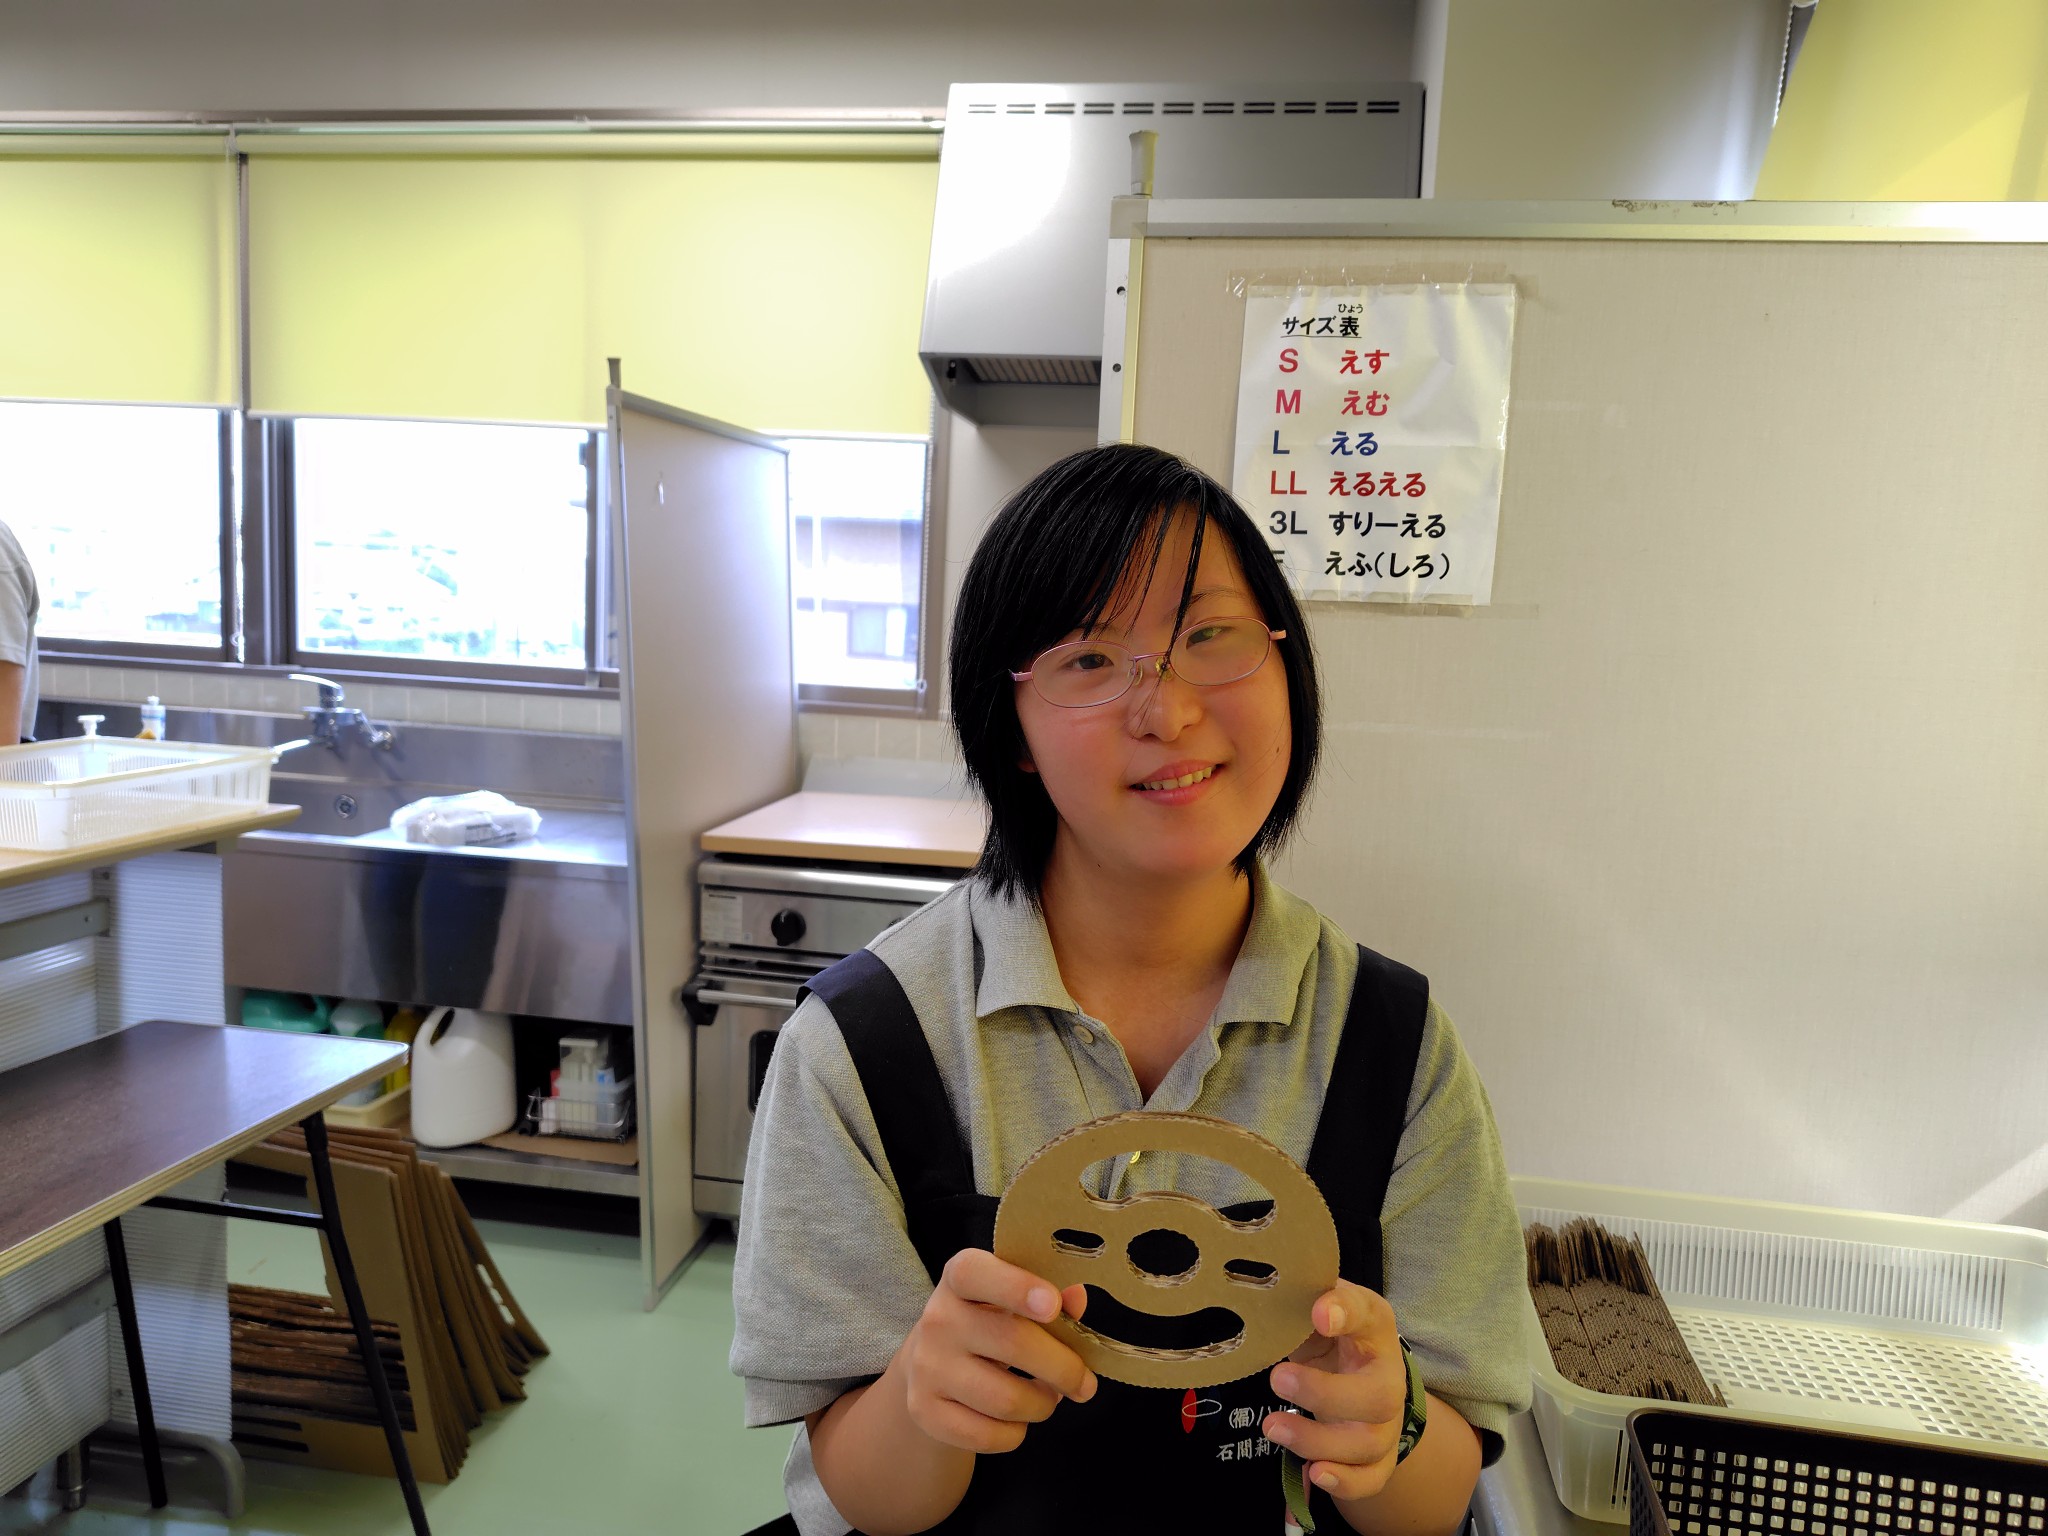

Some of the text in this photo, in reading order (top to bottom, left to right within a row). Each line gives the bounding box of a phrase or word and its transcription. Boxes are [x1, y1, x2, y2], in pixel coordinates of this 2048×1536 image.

[1338, 303, 1364, 314] ひょう
[1278, 348, 1390, 375] S えす
[1275, 389, 1390, 417] M えむ
[1272, 429, 1379, 456] L える
[1270, 470, 1426, 498] LL えるえる
[1269, 510, 1446, 539] 3L すりーえる
